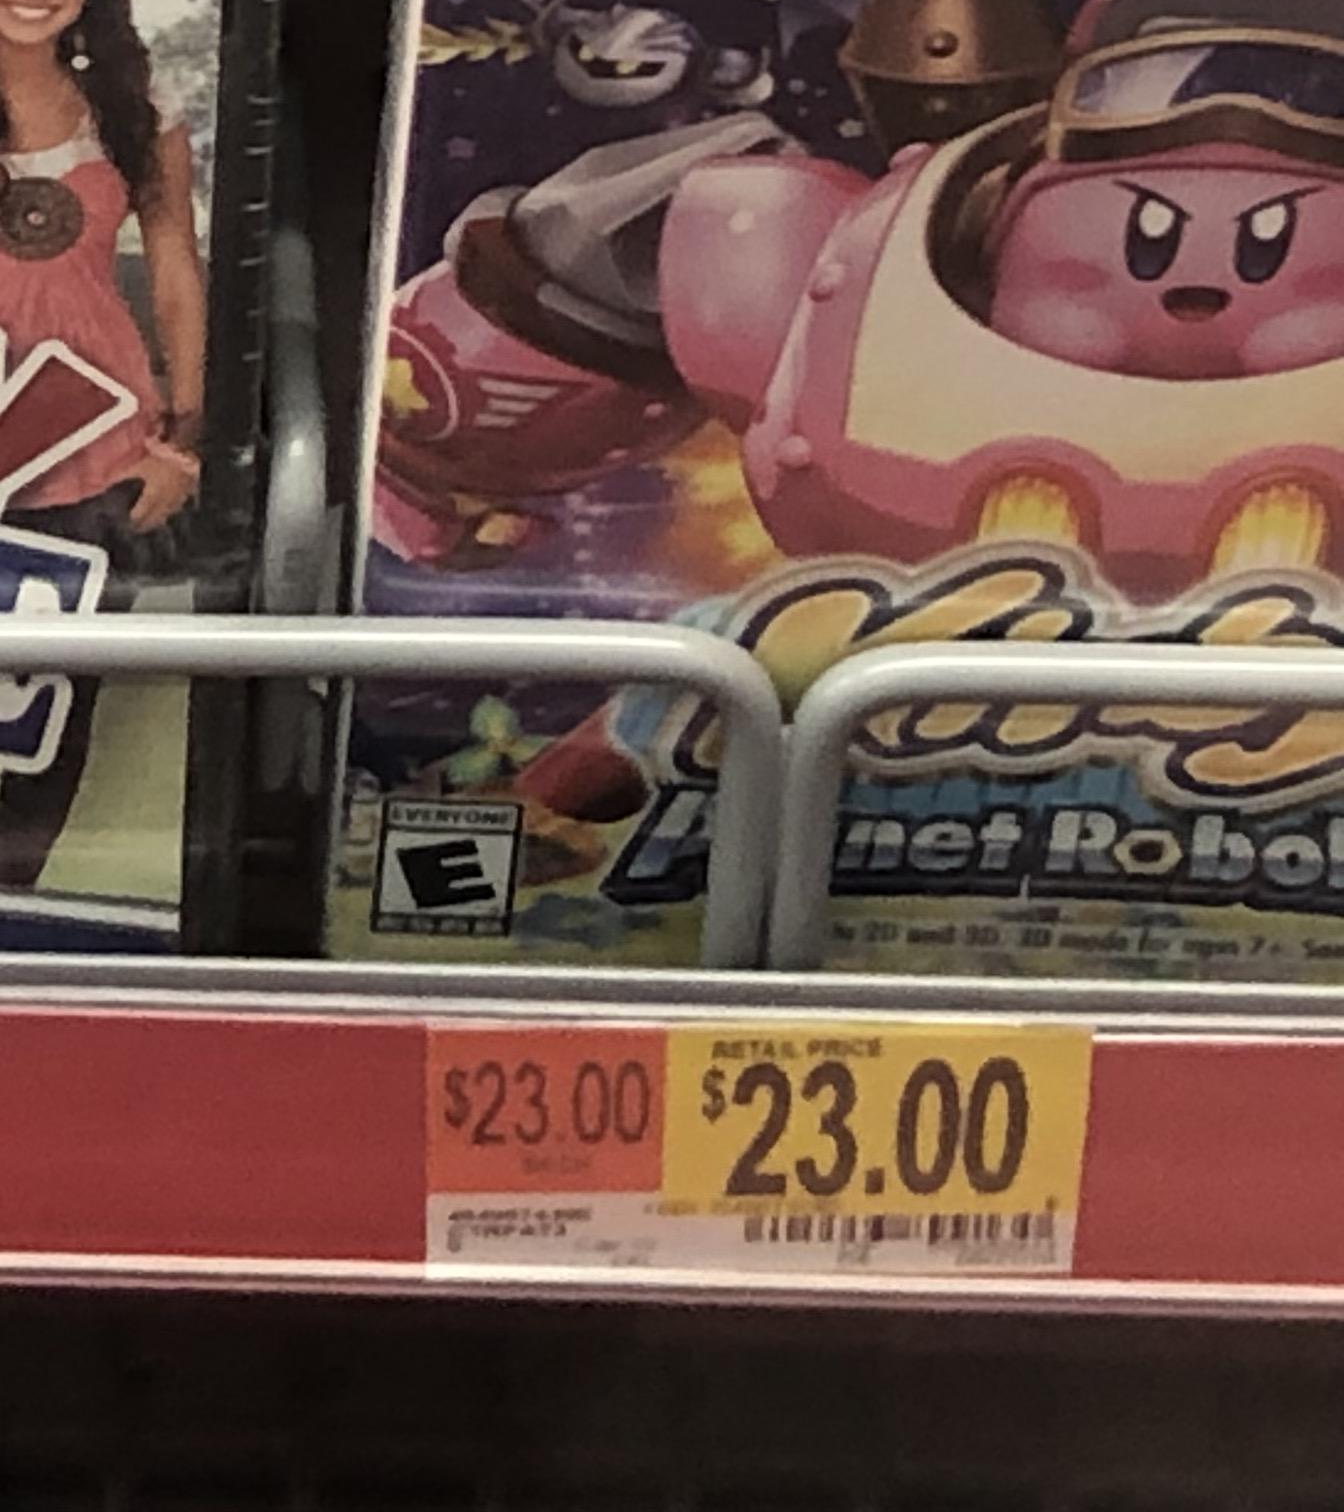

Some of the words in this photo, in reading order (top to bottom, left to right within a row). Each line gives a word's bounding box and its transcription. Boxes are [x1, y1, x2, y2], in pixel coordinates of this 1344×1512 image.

[397, 839, 497, 909] E
[1044, 808, 1344, 890] Robo
[444, 1059, 651, 1146] $23.00
[702, 1056, 1030, 1197] $23.00
